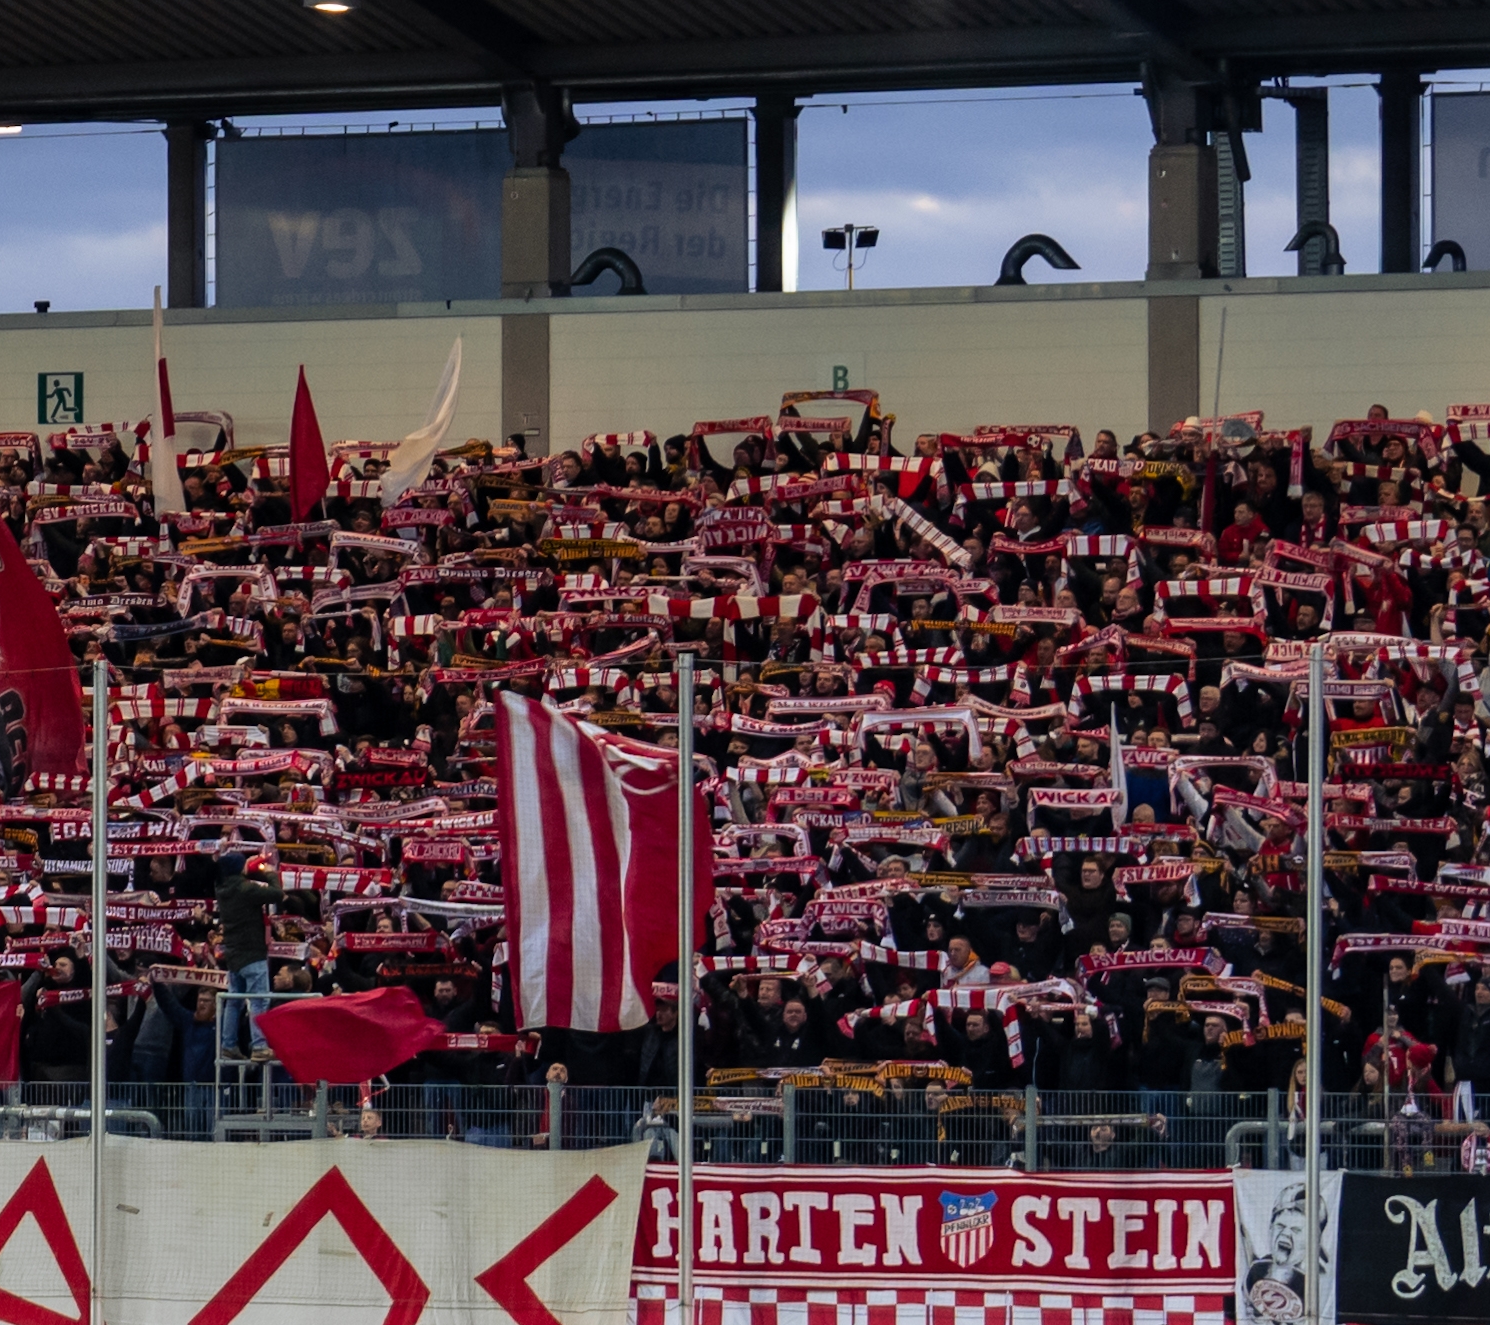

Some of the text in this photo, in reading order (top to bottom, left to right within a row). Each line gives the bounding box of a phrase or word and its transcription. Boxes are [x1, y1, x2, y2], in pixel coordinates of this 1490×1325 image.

[830, 366, 850, 393] B
[1090, 947, 1196, 967] FSV ZWICKAU
[651, 1186, 1226, 1271] HARTEN STEIN
